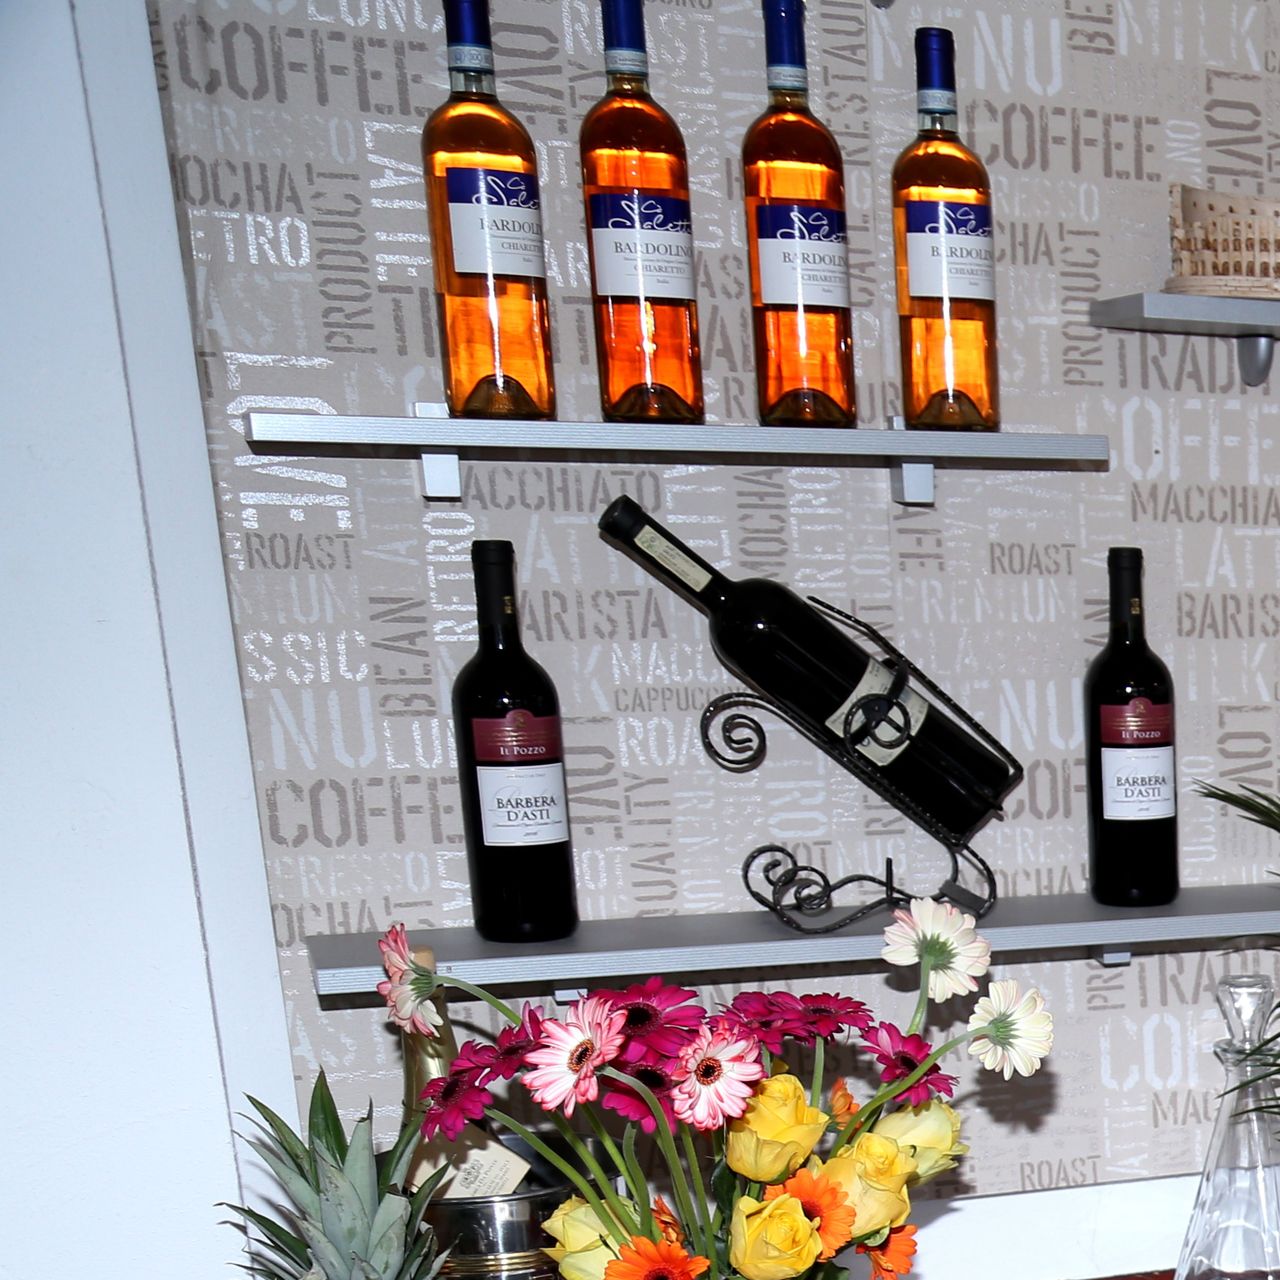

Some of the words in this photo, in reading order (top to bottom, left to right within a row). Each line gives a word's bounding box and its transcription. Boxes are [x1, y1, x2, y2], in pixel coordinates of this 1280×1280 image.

[174, 14, 432, 119] COFFEE
[965, 99, 1163, 184] COFFEE
[422, 465, 662, 515] ACCHIATO
[244, 531, 356, 571] ROAST
[988, 541, 1076, 576] ROAST
[369, 596, 437, 718] BEAN
[1115, 775, 1168, 787] BARBERA
[1124, 787, 1161, 799] D'ASTI
[495, 794, 558, 810] BARBERA
[506, 808, 551, 822] D'ASTI
[1019, 1156, 1102, 1194] ROAST
